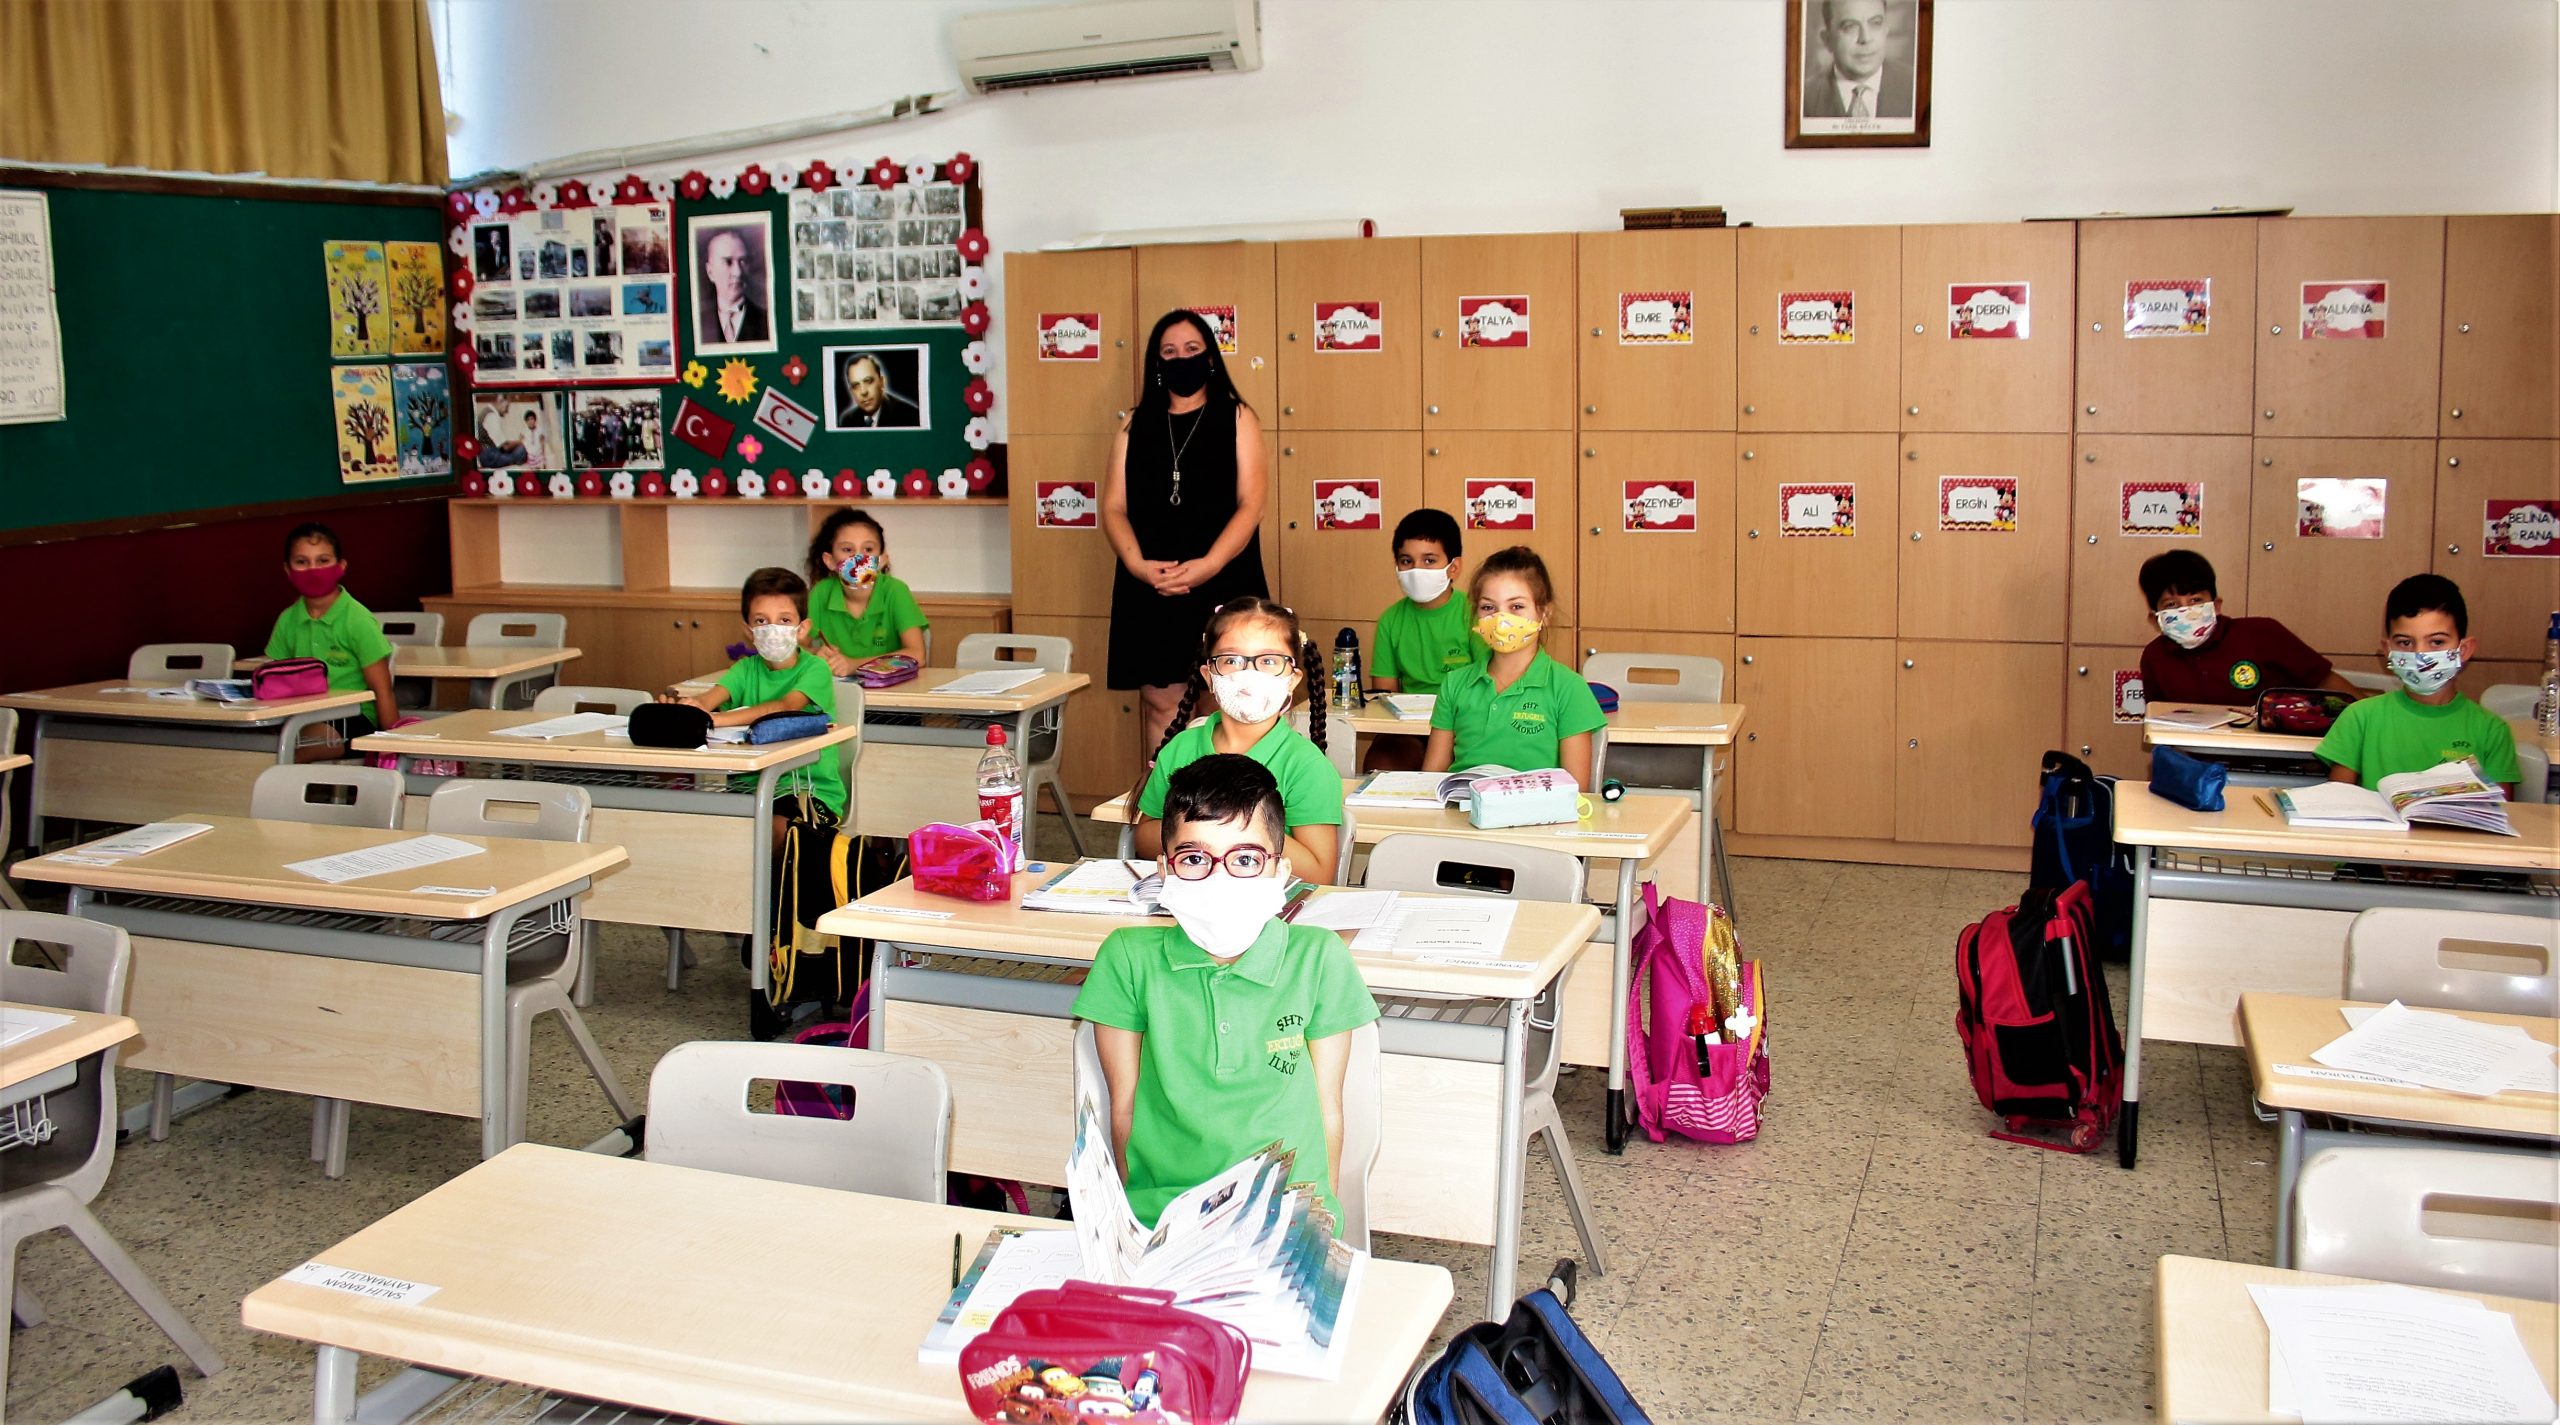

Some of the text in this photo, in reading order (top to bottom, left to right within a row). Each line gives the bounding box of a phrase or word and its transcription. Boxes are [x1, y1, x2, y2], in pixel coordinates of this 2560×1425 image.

[1790, 310, 1832, 320] EGEMEN
[1976, 304, 2010, 315] DEREN
[1480, 316, 1513, 325] TALYA
[1635, 313, 1661, 322] EMRE
[1334, 319, 1368, 329] FATMA
[1057, 329, 1087, 339] BAHAR
[1054, 497, 1085, 510] NEVŞİN
[1339, 497, 1361, 508] İREM
[1488, 498, 1517, 509] MEHRİ
[1644, 498, 1682, 508] ZEYNEP
[1956, 497, 1987, 509] ERGİN
[1803, 505, 1818, 517] ALİ
[2144, 504, 2168, 514] ATA
[2508, 512, 2550, 523] BELİNA
[2520, 530, 2551, 541] RANA
[1276, 1014, 1304, 1032] ŞHT
[322, 1278, 366, 1293] BARAN
[967, 1354, 1021, 1390] FRIENDS
